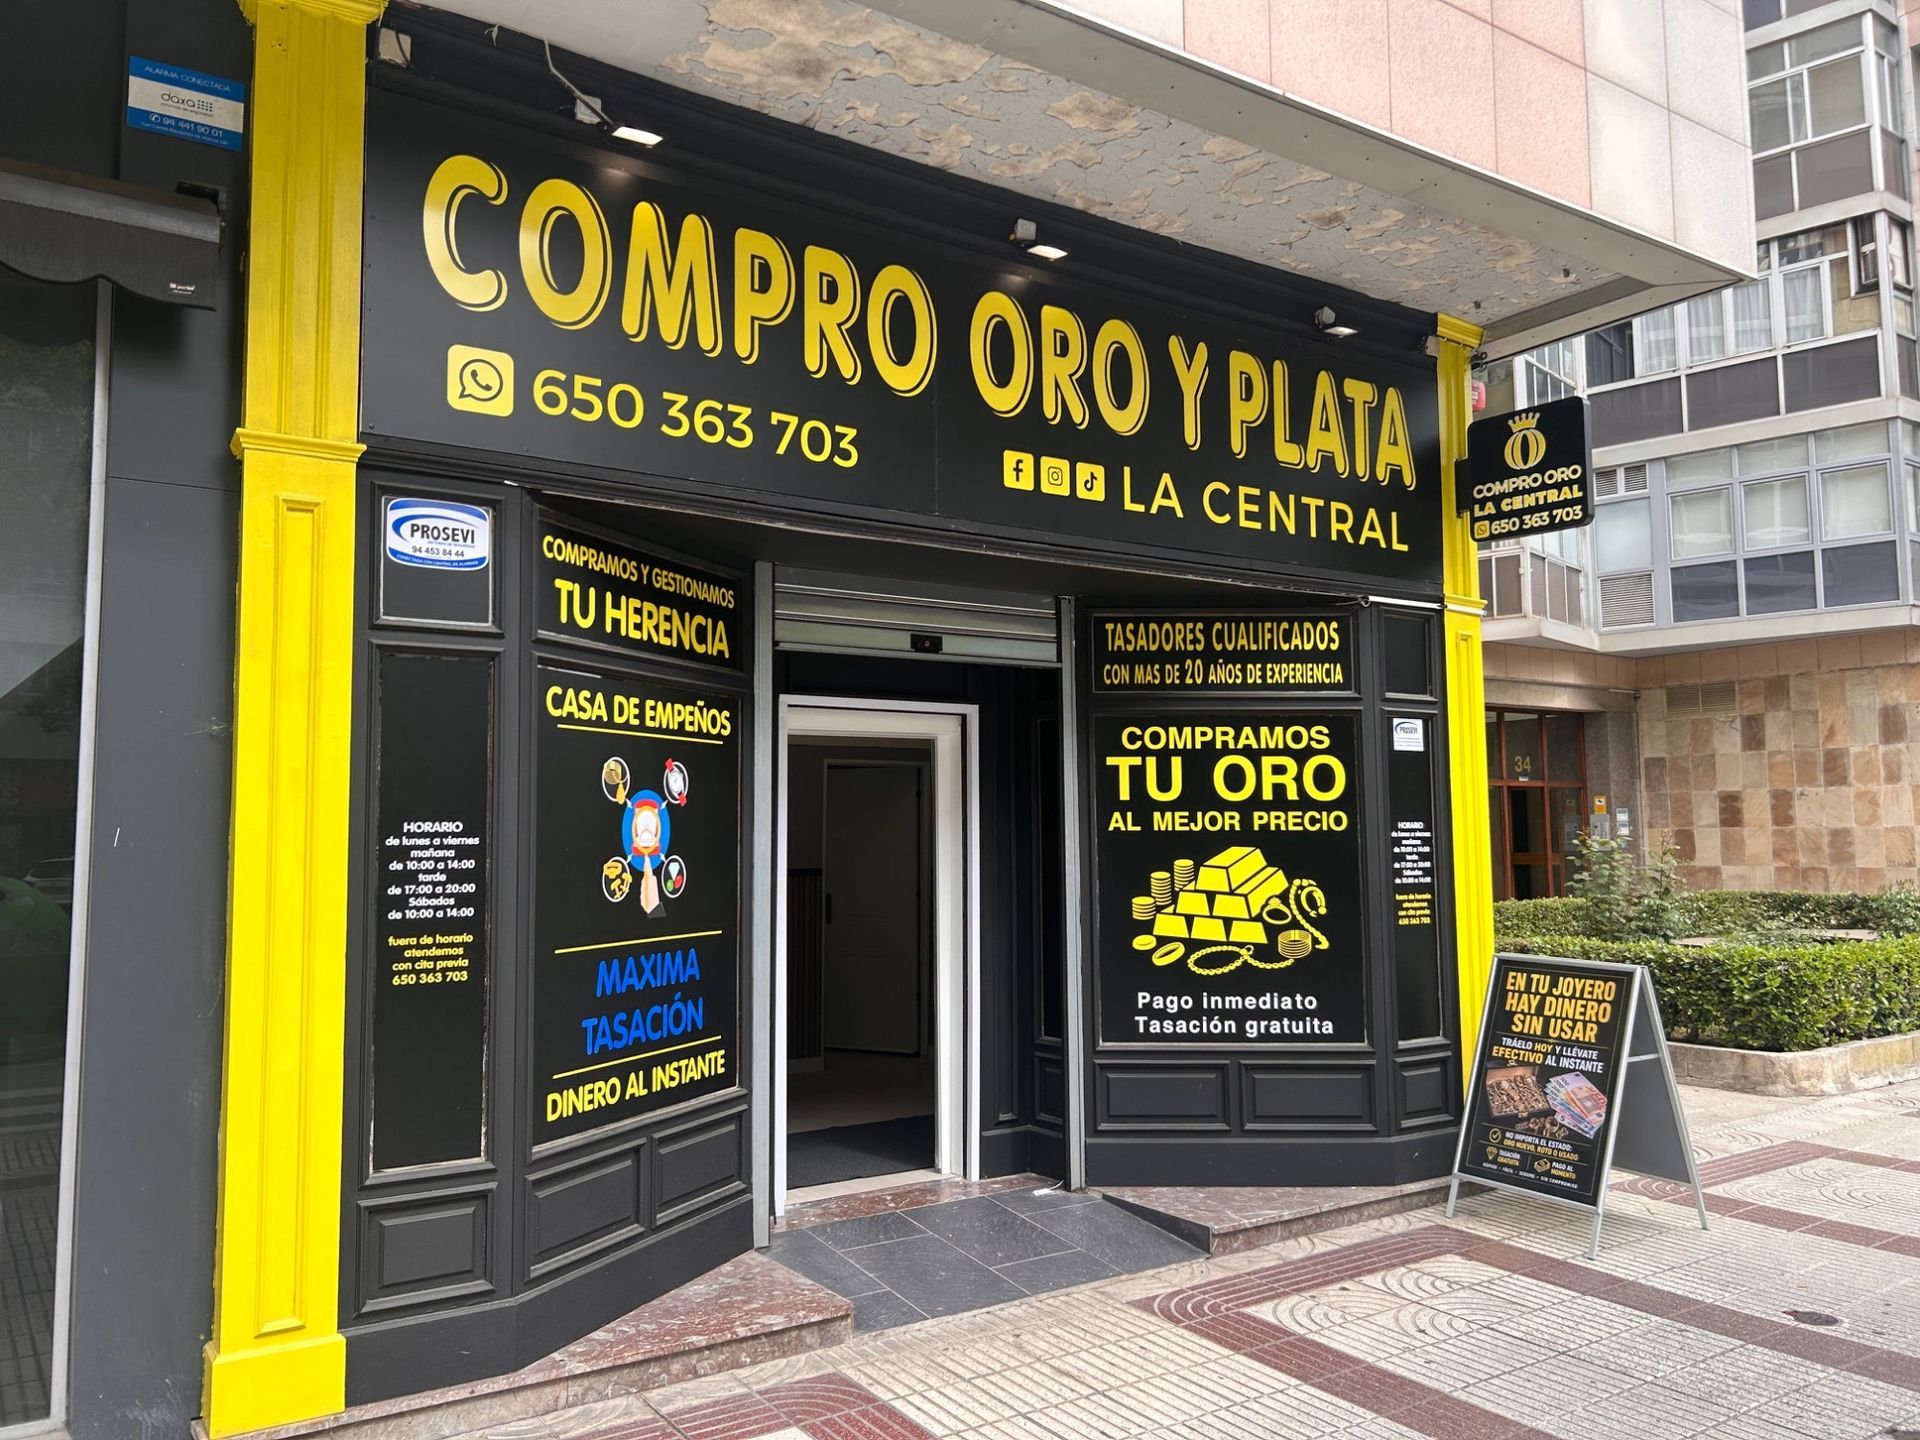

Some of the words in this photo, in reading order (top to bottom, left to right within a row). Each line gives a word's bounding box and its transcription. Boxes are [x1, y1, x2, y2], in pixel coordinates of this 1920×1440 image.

[144, 65, 179, 79] ALARMA
[180, 74, 231, 92] CONECTADA
[161, 92, 196, 108] daxa
[162, 117, 175, 126] 94
[178, 120, 194, 130] 441
[196, 124, 210, 135] 90
[211, 128, 223, 137] 01
[423, 154, 937, 397] COMPRO
[970, 291, 1150, 436] ORO
[1168, 335, 1209, 451] Y
[1229, 350, 1416, 491] PLATA
[533, 369, 644, 429] 650
[661, 392, 753, 449] 363
[770, 412, 859, 468] 703
[1473, 473, 1542, 499] COMPRO
[1543, 464, 1582, 484] ORO
[1123, 466, 1184, 519] LA
[1202, 481, 1409, 552] CENTRAL
[1474, 502, 1496, 517] LA
[1500, 484, 1583, 512] CENTRAL
[1491, 517, 1519, 535] 650
[1522, 511, 1550, 529] 363
[1553, 505, 1583, 523] 703
[410, 523, 475, 544] PROSEVI
[412, 545, 422, 553] 94
[424, 546, 440, 555] 453
[442, 548, 452, 557] 84
[542, 535, 638, 582] COMPRAMOS
[640, 564, 650, 585] Y
[652, 568, 735, 609] GESTIONAMOS
[554, 578, 596, 629] TU
[605, 591, 729, 659] HERENCIA
[1105, 622, 1205, 651] TASADORES
[1212, 621, 1340, 651] CUALIFICADOS
[1103, 663, 1130, 685] CON
[1134, 663, 1161, 685] MAS
[1165, 663, 1180, 684] DE
[1185, 658, 1203, 684] 20
[1208, 659, 1242, 684] AÑOS
[1246, 663, 1262, 684] DE
[1266, 662, 1343, 684] EXPERIENCIA
[546, 685, 608, 722] CASA
[613, 694, 640, 726] DE
[645, 700, 731, 736] EMPEÑOS
[1121, 725, 1330, 750] COMPRAMOS
[1514, 755, 1531, 773] 34
[1106, 755, 1182, 801] TU
[1212, 754, 1346, 801] ORO
[403, 821, 463, 833] HORARIO
[1107, 811, 1142, 831] AL
[1153, 811, 1241, 831] MEJOR
[1253, 810, 1348, 831] PRECIO
[385, 836, 400, 846] de
[402, 836, 431, 846] lunes
[432, 838, 441, 846] a
[442, 836, 480, 845] viernes
[410, 848, 455, 858] mañana
[388, 860, 403, 871] de
[406, 860, 435, 870] 10:00
[436, 861, 445, 870] a
[447, 859, 475, 869] 14:00
[417, 872, 446, 882] tarde
[387, 885, 402, 895] de
[404, 884, 433, 895] 17:00
[435, 885, 443, 894] a
[445, 883, 476, 894] 20:00
[408, 896, 455, 907] Sábados
[387, 909, 402, 920] de
[405, 908, 434, 919] 10:00
[435, 910, 444, 918] a
[446, 907, 474, 918] 14:00
[388, 935, 417, 947] fuera
[419, 934, 433, 945] de
[435, 932, 473, 944] horario
[404, 946, 464, 958] atendemos
[392, 960, 412, 971] con
[414, 959, 434, 970] cita
[436, 957, 469, 971] previa
[596, 947, 701, 998] MAXIMA
[392, 974, 416, 986] 650
[419, 972, 442, 984] 363
[445, 971, 468, 983] 703
[1506, 971, 1527, 991] EN
[1530, 973, 1550, 994] TU
[1552, 976, 1616, 1001] JOYERO
[1137, 991, 1193, 1013] Pago
[1202, 991, 1318, 1010] inmediato
[1505, 991, 1541, 1014] HAY
[1544, 996, 1612, 1023] DINERO
[581, 991, 704, 1056] TASACIÓN
[1135, 1015, 1237, 1034] Tasación
[1245, 1016, 1334, 1038] gratuita
[1511, 1013, 1544, 1036] SIN
[1548, 1018, 1598, 1043] USAR
[1502, 1036, 1532, 1050] TRÁELO
[1534, 1042, 1553, 1053] HOY
[1555, 1045, 1561, 1054] Y
[1562, 1046, 1599, 1060] LLÉVATE
[1492, 1045, 1544, 1064] EFECTIVO
[1545, 1055, 1557, 1066] AL
[1559, 1056, 1604, 1074] INSTANTE
[546, 1076, 621, 1123] DINERO
[625, 1070, 648, 1099] AL
[651, 1049, 725, 1092] INSTANTE
[1503, 1139, 1515, 1147] ORO
[1537, 1146, 1552, 1155] ROTO
[1553, 1149, 1558, 1157] O
[1558, 1150, 1579, 1161] USADO
[1505, 1131, 1514, 1139] NO
[1514, 1132, 1539, 1145] IMPORTA
[1540, 1138, 1547, 1146] EL
[1548, 1140, 1573, 1152] ESTADO:
[1550, 1168, 1576, 1179] MOMENTO
[1551, 1161, 1567, 1170] PAGO
